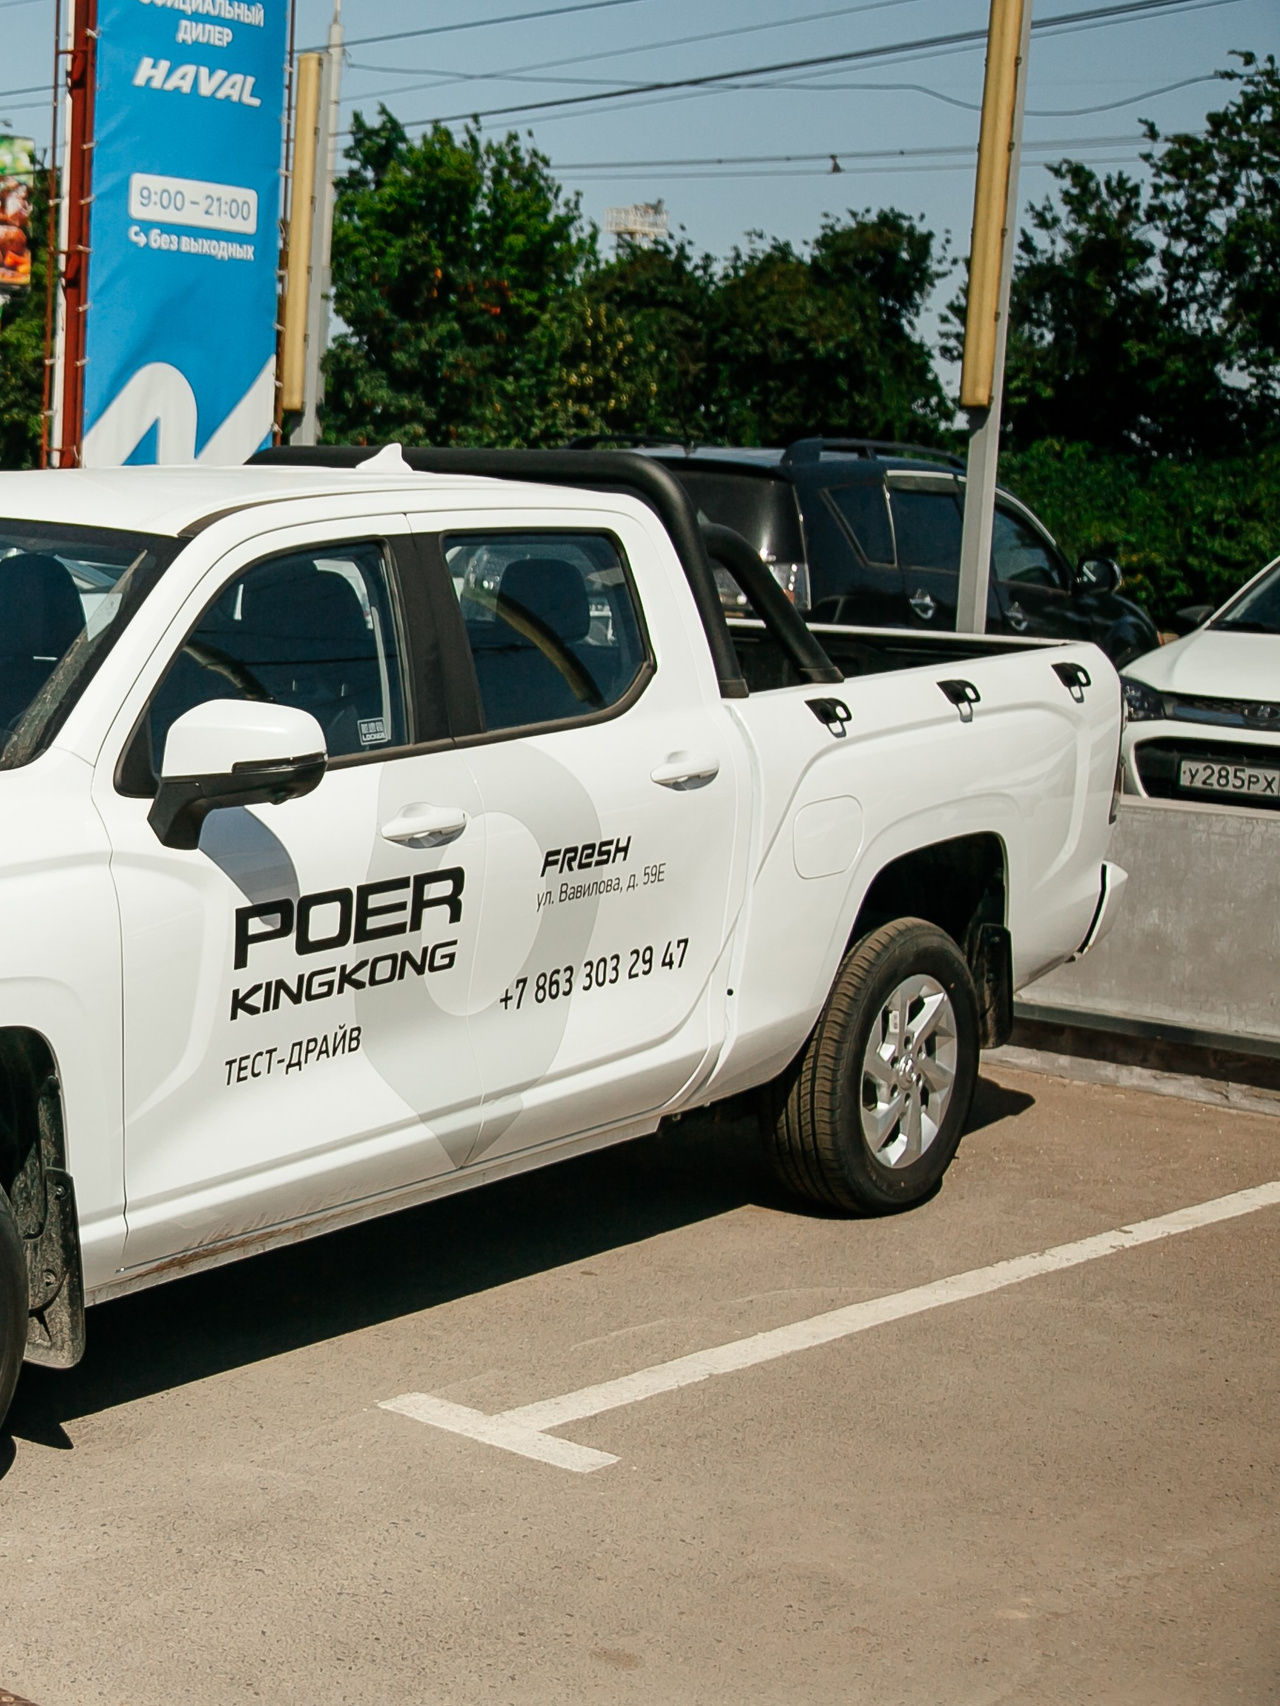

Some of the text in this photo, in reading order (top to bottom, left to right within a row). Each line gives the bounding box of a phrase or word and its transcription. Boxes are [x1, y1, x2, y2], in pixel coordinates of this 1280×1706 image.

[176, 19, 233, 48] ДИЛЕР
[132, 56, 261, 107] HAVAL
[148, 229, 254, 261] без выходных
[234, 866, 465, 970] POER
[537, 890, 554, 913] ул.
[559, 877, 623, 904] Вавилова,
[626, 873, 638, 892] д.
[230, 939, 458, 1021] KINGKONG
[499, 937, 689, 1010] +7 863 303 29 47
[225, 1023, 362, 1086] ТЕСТ-ДРАЙВ
